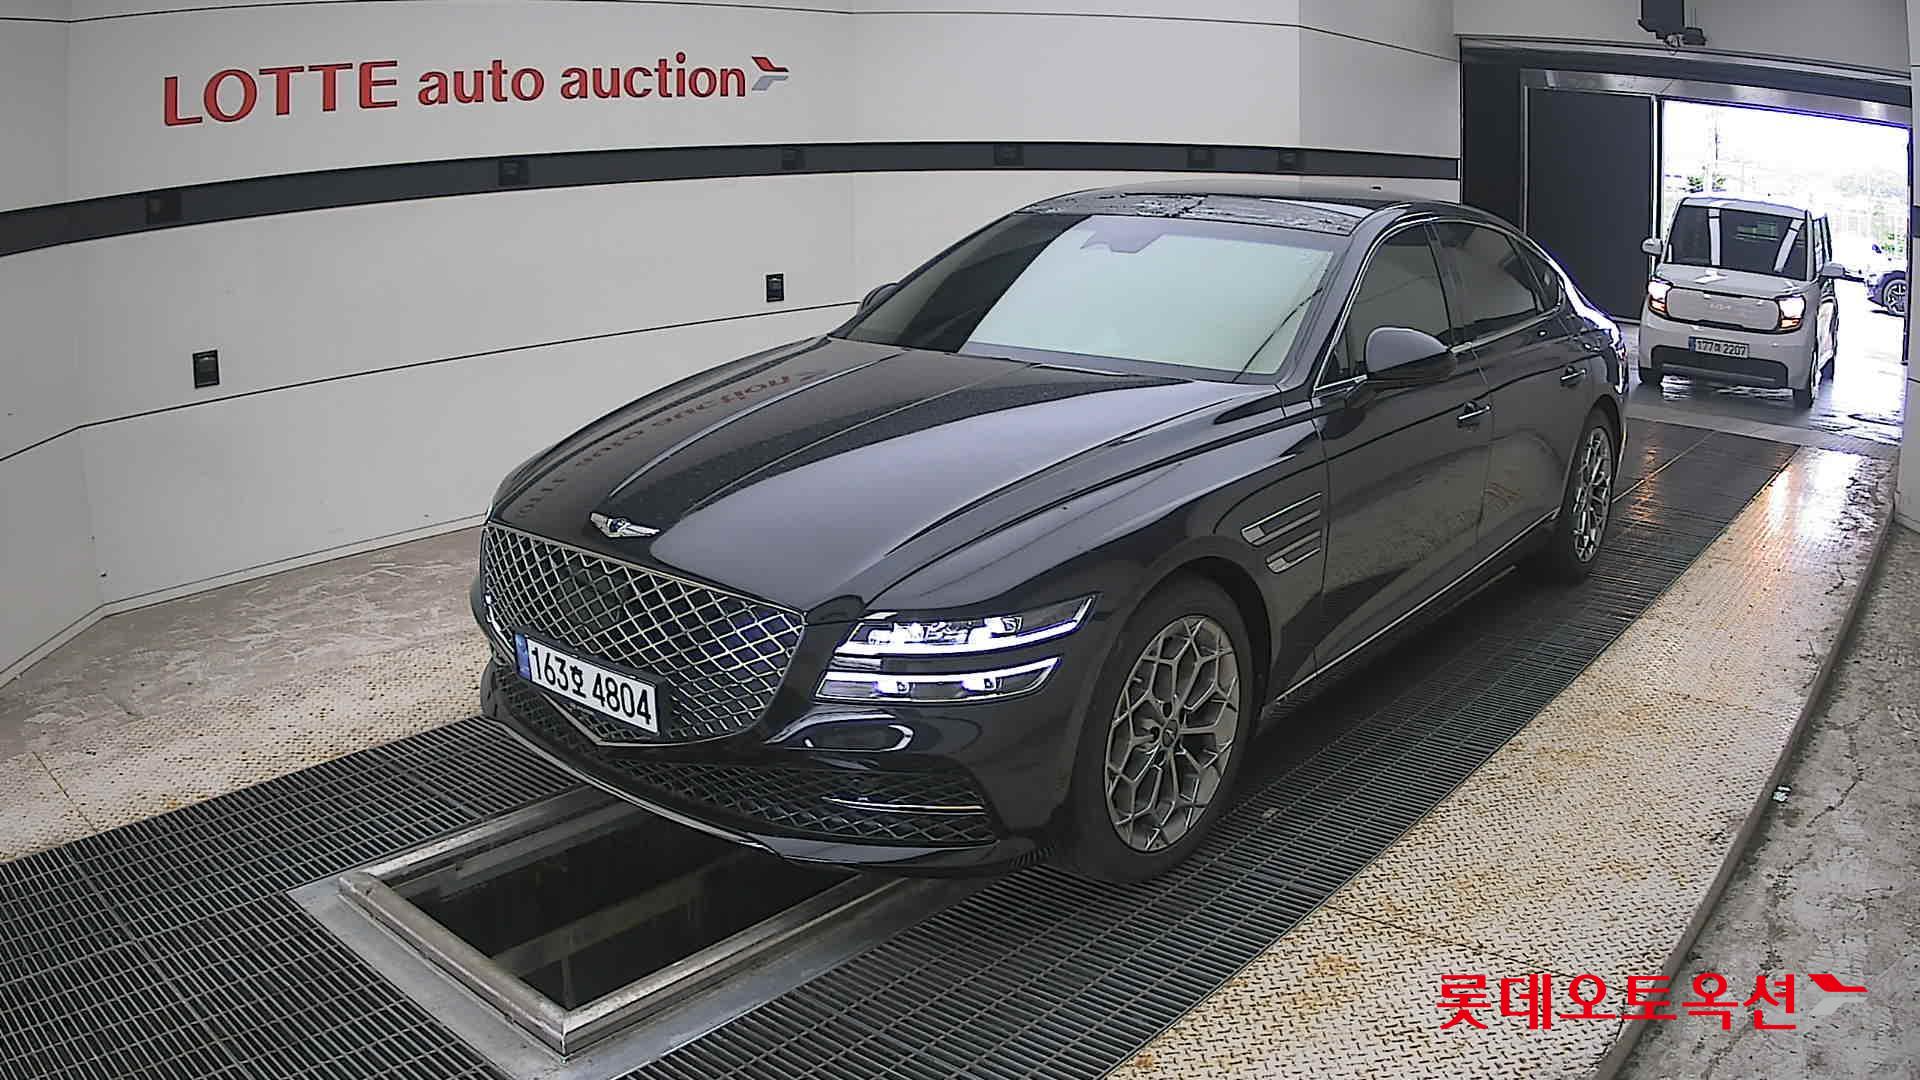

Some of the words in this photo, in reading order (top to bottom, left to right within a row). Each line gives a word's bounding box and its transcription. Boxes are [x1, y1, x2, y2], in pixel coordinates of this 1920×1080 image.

[164, 60, 398, 126] LOTTE
[417, 58, 544, 105] auto
[560, 52, 747, 99] auction
[531, 647, 586, 698] 163호
[592, 672, 652, 725] 4804
